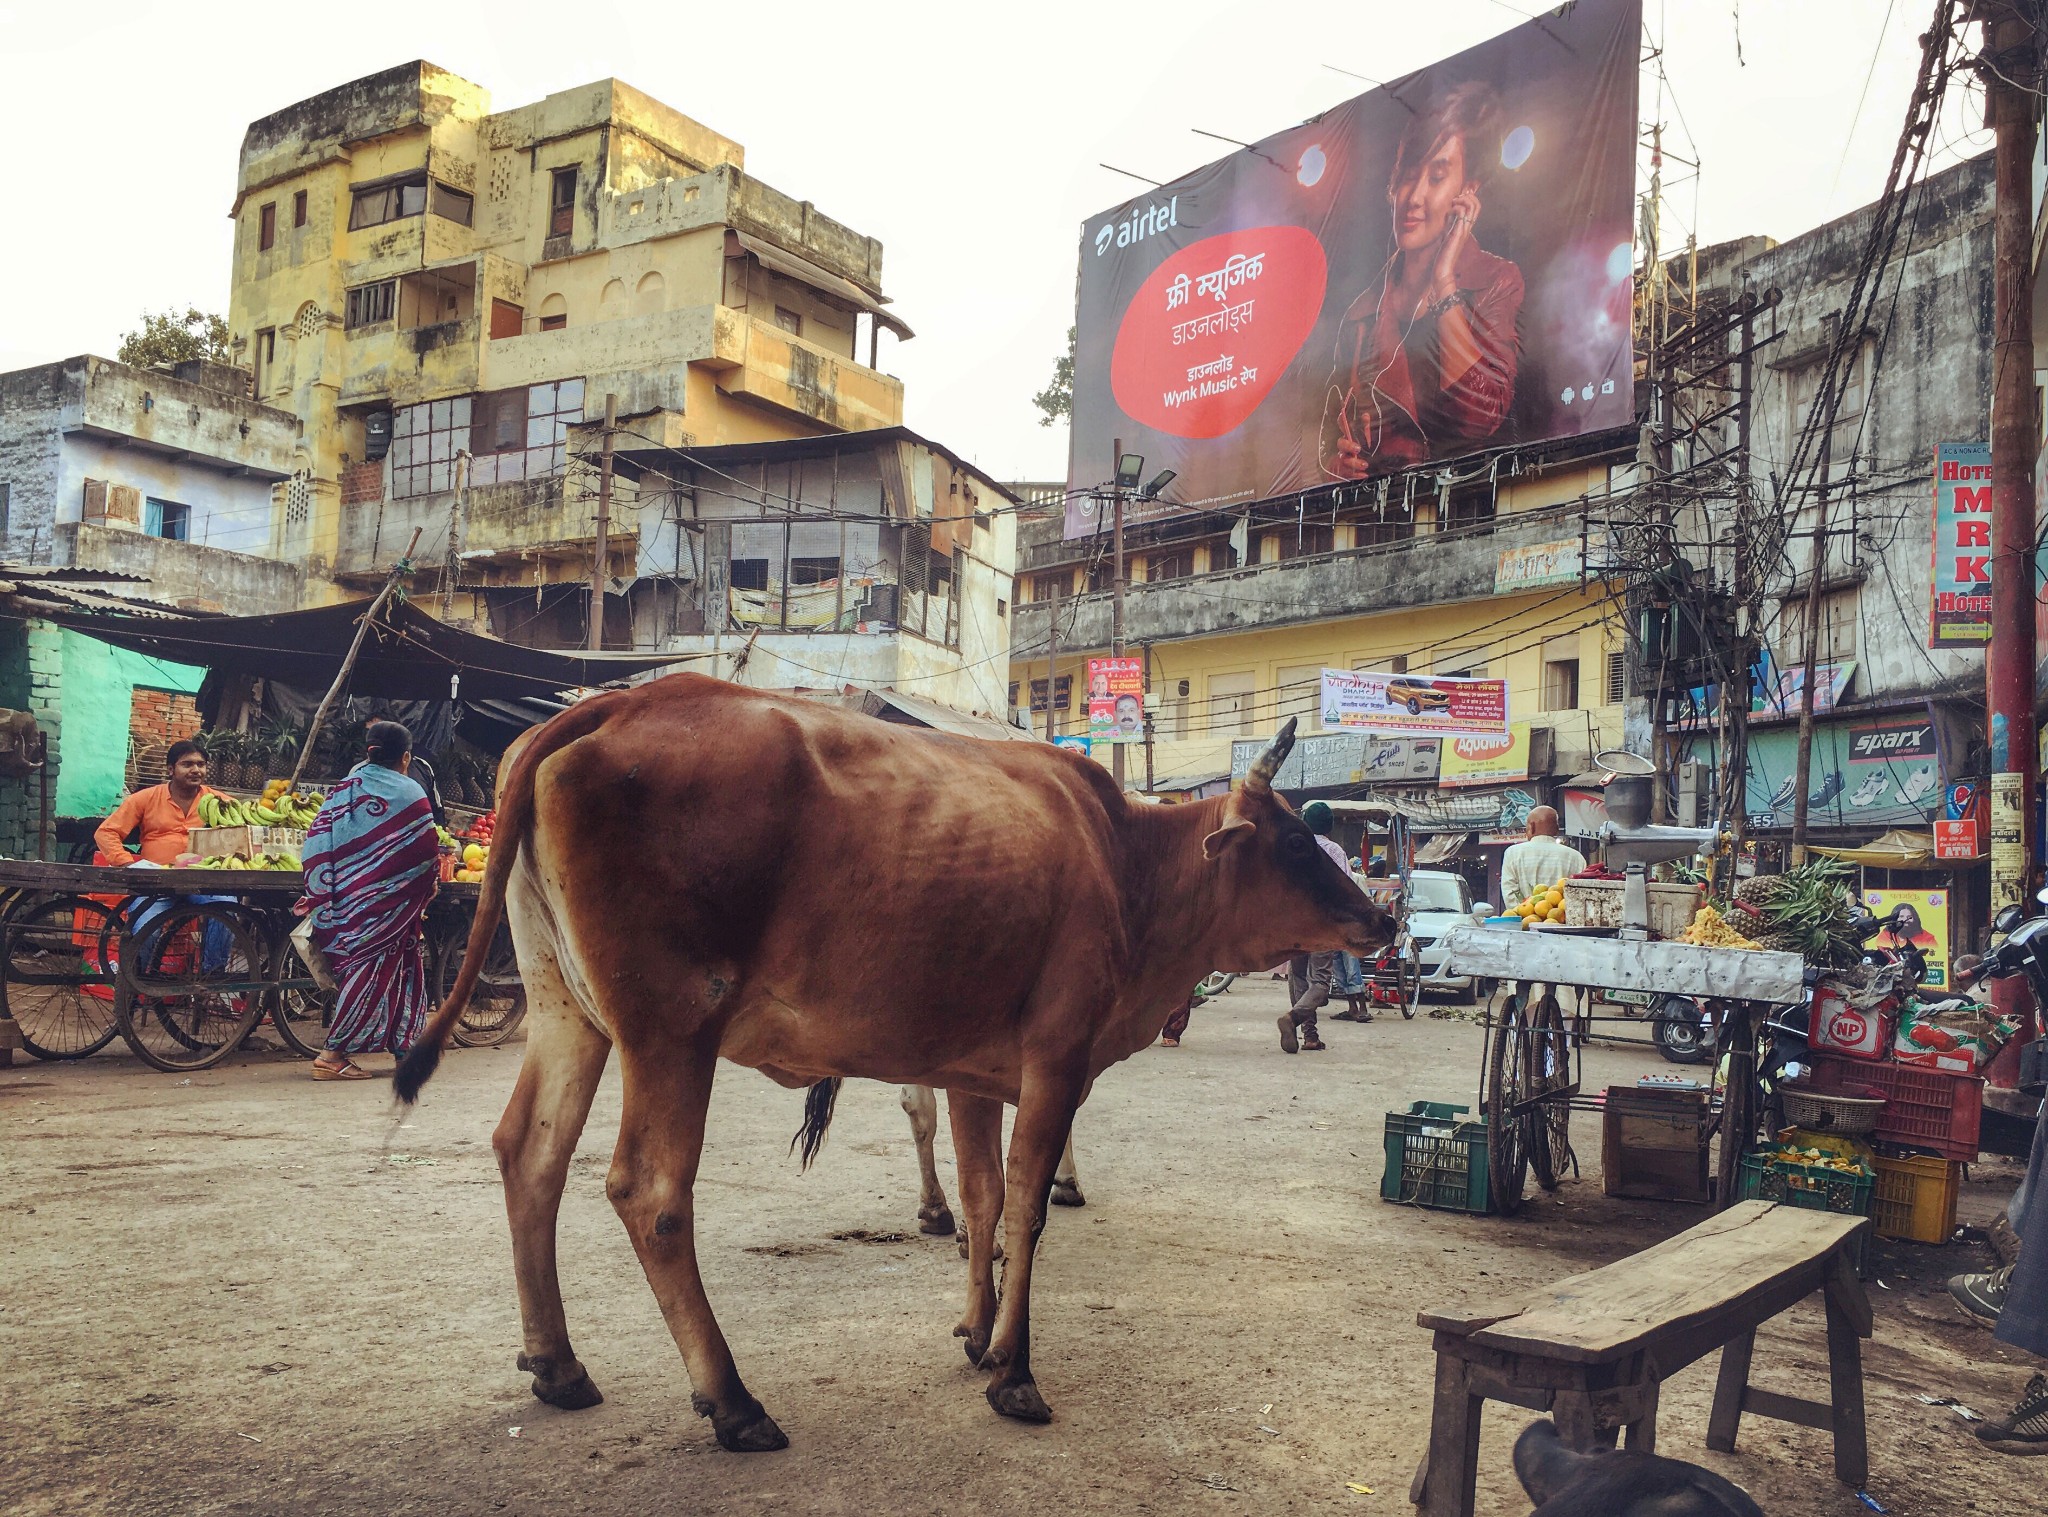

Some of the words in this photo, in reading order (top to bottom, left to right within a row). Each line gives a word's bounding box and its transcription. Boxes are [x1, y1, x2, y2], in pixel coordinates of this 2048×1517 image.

[1116, 195, 1178, 248] airtel
[1165, 273, 1192, 311] फ्री
[1195, 252, 1266, 302] म्यूजिक
[1171, 299, 1256, 345] डाउनलोड्स
[1187, 354, 1235, 382] डाउनलोड
[1163, 384, 1198, 408] Wynk
[1199, 374, 1238, 398] Music
[1854, 726, 1931, 755] sparx
[1944, 846, 1972, 857] ATM
[1836, 1021, 1860, 1037] NP
